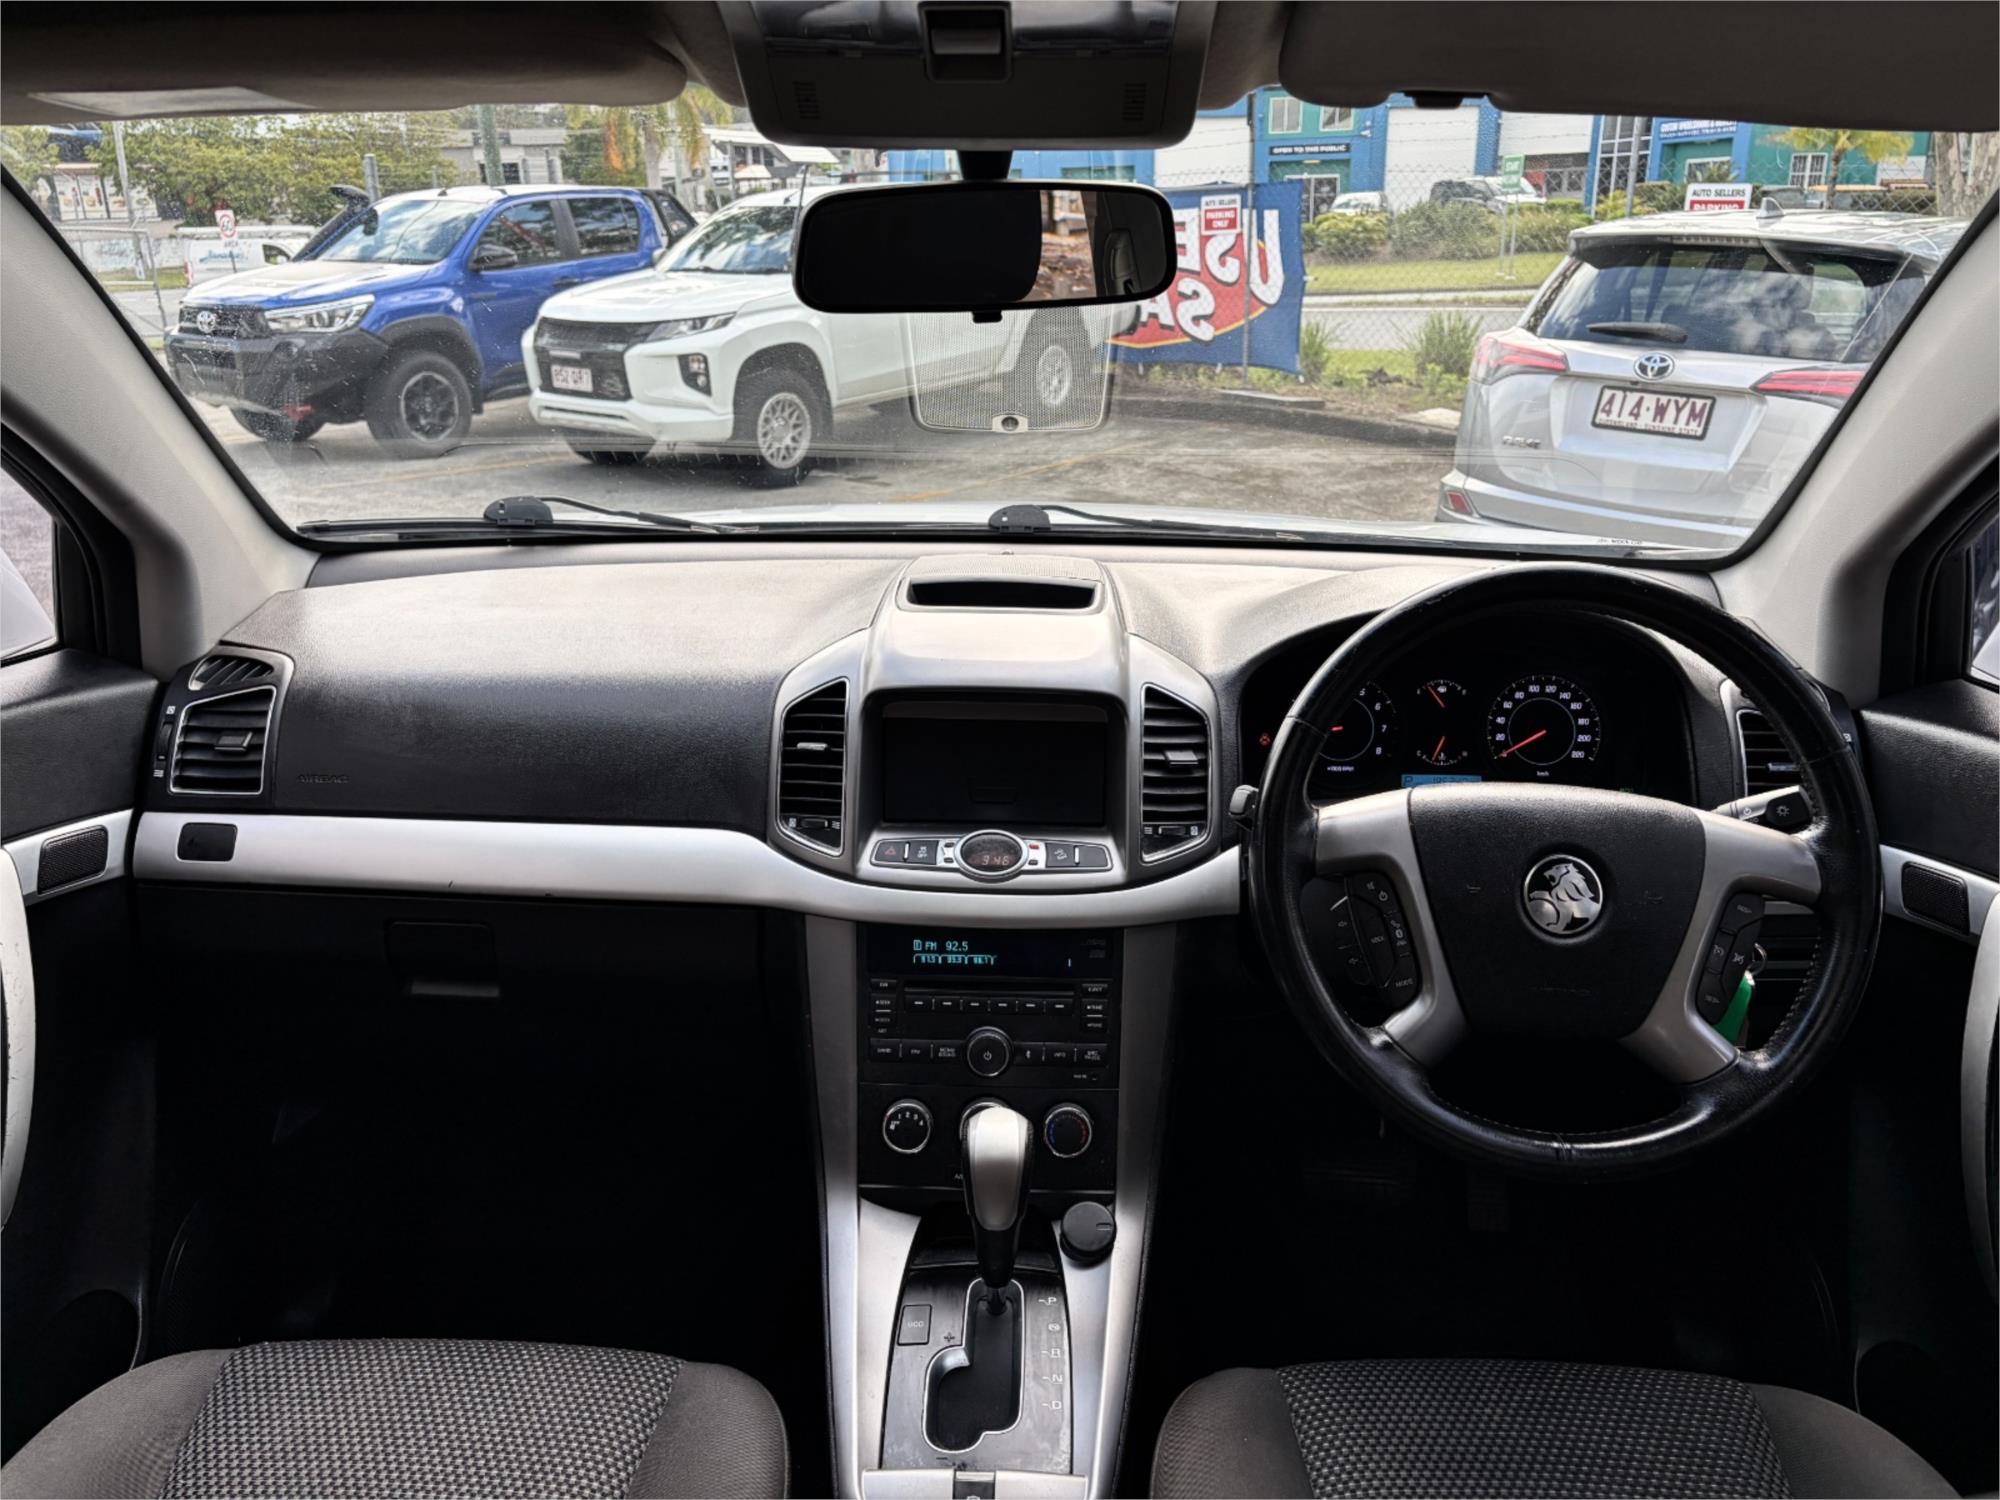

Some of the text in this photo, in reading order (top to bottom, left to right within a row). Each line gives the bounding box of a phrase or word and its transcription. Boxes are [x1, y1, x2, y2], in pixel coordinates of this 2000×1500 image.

[1320, 144, 1347, 152] PUBLIC
[1692, 188, 1746, 198] AUTO SELLERS
[1211, 219, 1230, 228] ONLY
[1528, 684, 1541, 693] 100
[1545, 685, 1558, 693] 120
[1514, 691, 1525, 700] 80
[1560, 691, 1572, 700] 140
[1374, 702, 1381, 711] 6
[1503, 701, 1513, 709] 60
[1570, 702, 1583, 710] 160
[1495, 716, 1506, 725] 40
[1577, 718, 1590, 726] 180
[1381, 724, 1388, 733] 7
[1495, 733, 1506, 741] 20
[1577, 734, 1592, 742] 200
[1375, 747, 1382, 755] 8
[1571, 750, 1585, 759] 220
[925, 940, 969, 951] FM 92.5
[1052, 1373, 1063, 1384] N
[1052, 1399, 1062, 1410] D
